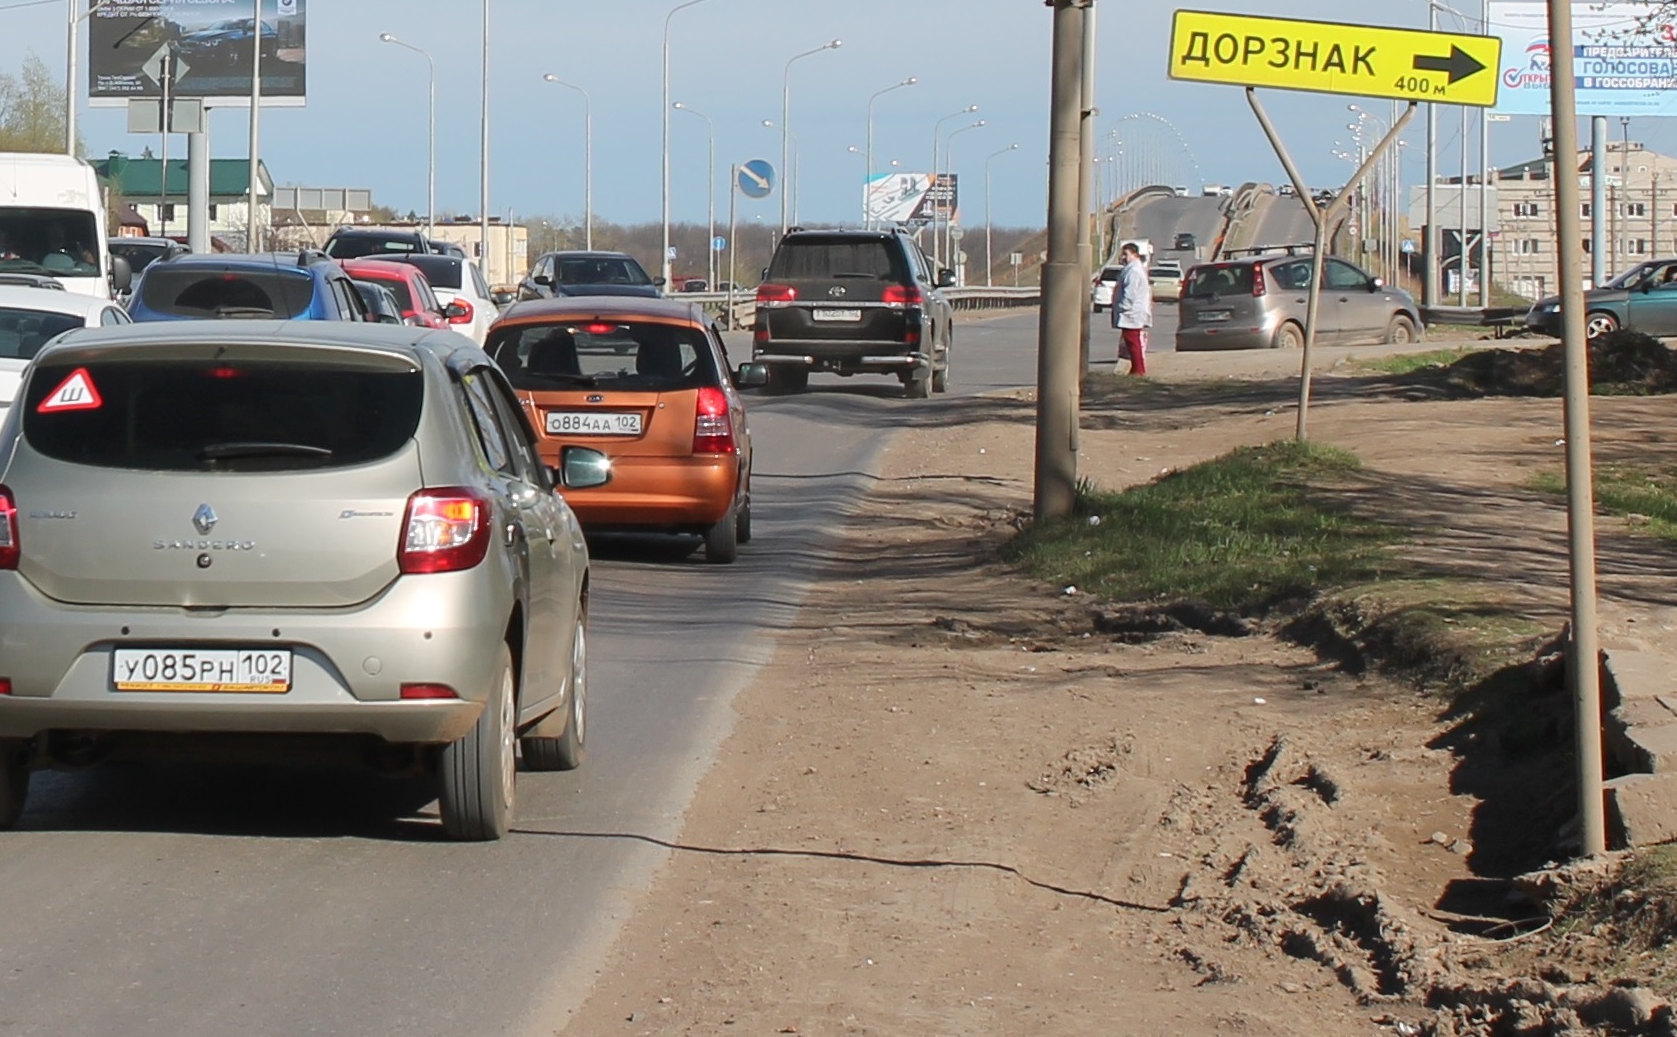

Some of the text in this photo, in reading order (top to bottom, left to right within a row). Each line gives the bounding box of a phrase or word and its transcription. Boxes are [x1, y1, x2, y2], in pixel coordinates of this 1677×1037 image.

[1181, 30, 1377, 77] ДОРЗНАК
[1394, 75, 1430, 94] 400
[1584, 78, 1593, 88] В
[60, 386, 85, 403] Ш
[551, 415, 637, 431] О884АА 102
[153, 540, 256, 551] SANDERO
[125, 653, 283, 682] У085РН 102
